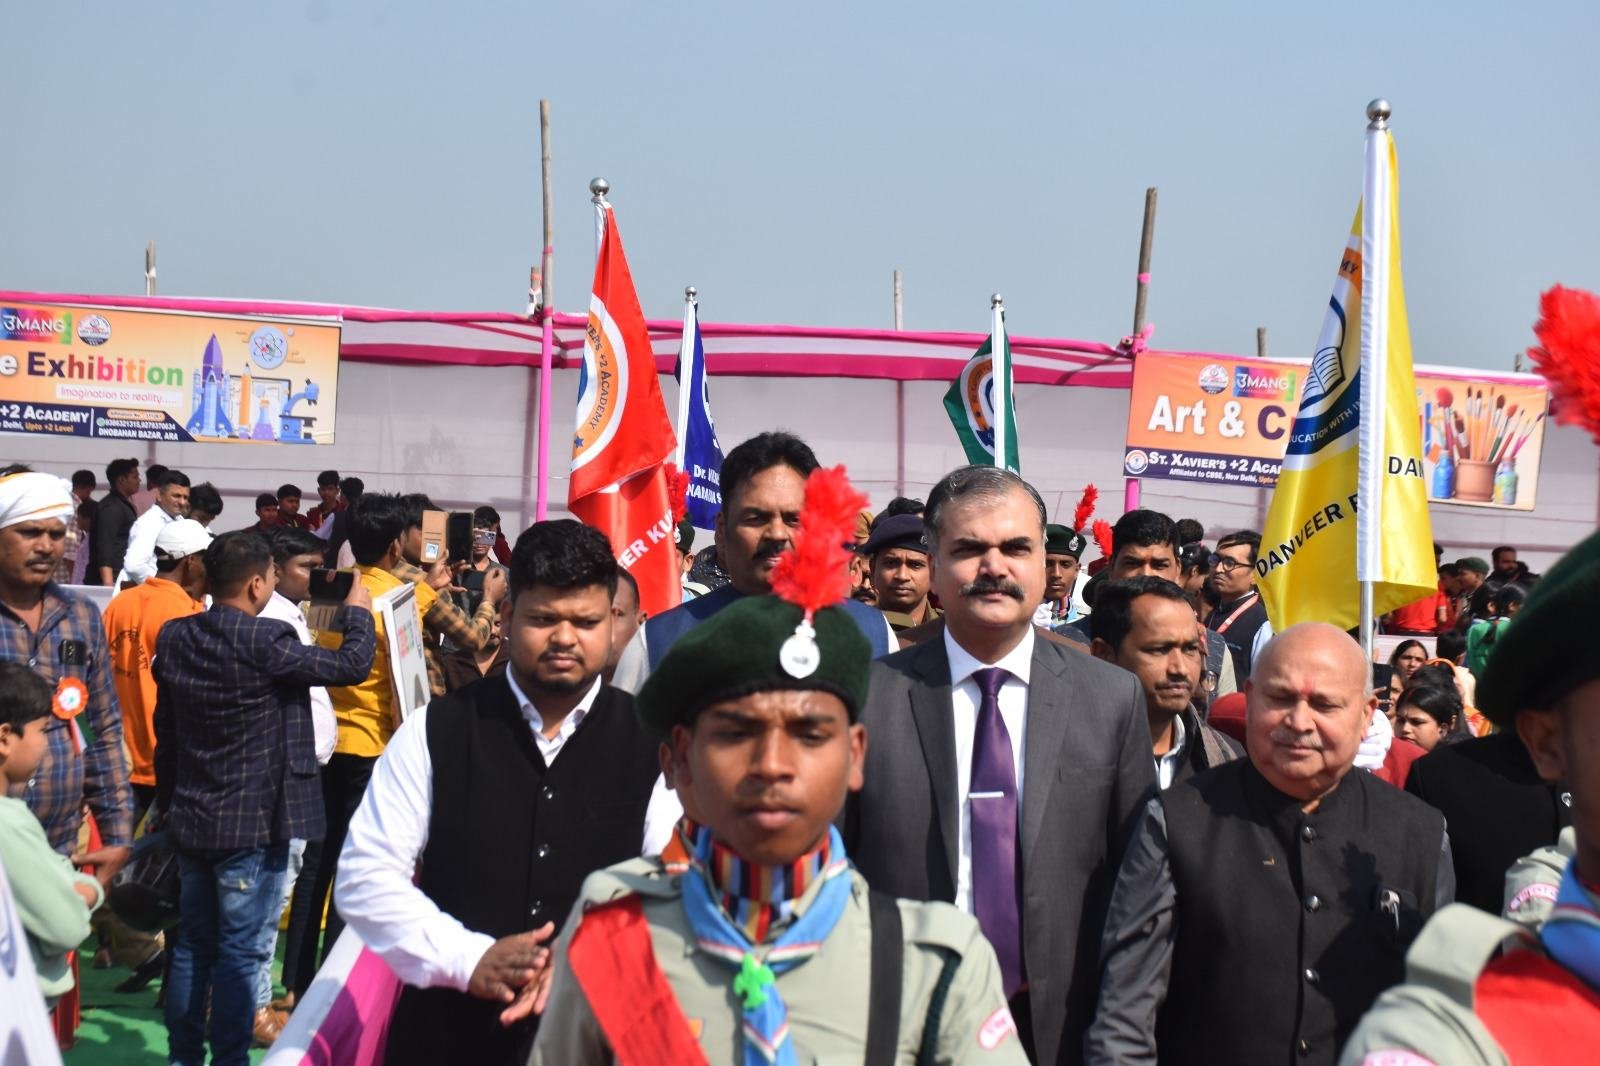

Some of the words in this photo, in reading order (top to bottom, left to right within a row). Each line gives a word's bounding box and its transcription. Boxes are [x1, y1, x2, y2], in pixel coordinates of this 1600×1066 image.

[27, 351, 183, 386] Exhibition
[61, 386, 117, 400] Imagination
[120, 391, 129, 400] to
[0, 404, 20, 419] +2
[23, 405, 90, 423] ACADEMY
[1147, 395, 1207, 435] Art
[1218, 400, 1246, 438] &
[54, 424, 74, 433] Level
[1290, 428, 1328, 443] UCATION
[1329, 408, 1353, 429] WITH
[693, 464, 706, 479] Dr.
[1148, 451, 1168, 465] ST.
[1171, 453, 1227, 470] XAVIER'S
[1230, 458, 1248, 473] +2
[1198, 469, 1205, 478] to
[1256, 503, 1344, 578] DANVEER
